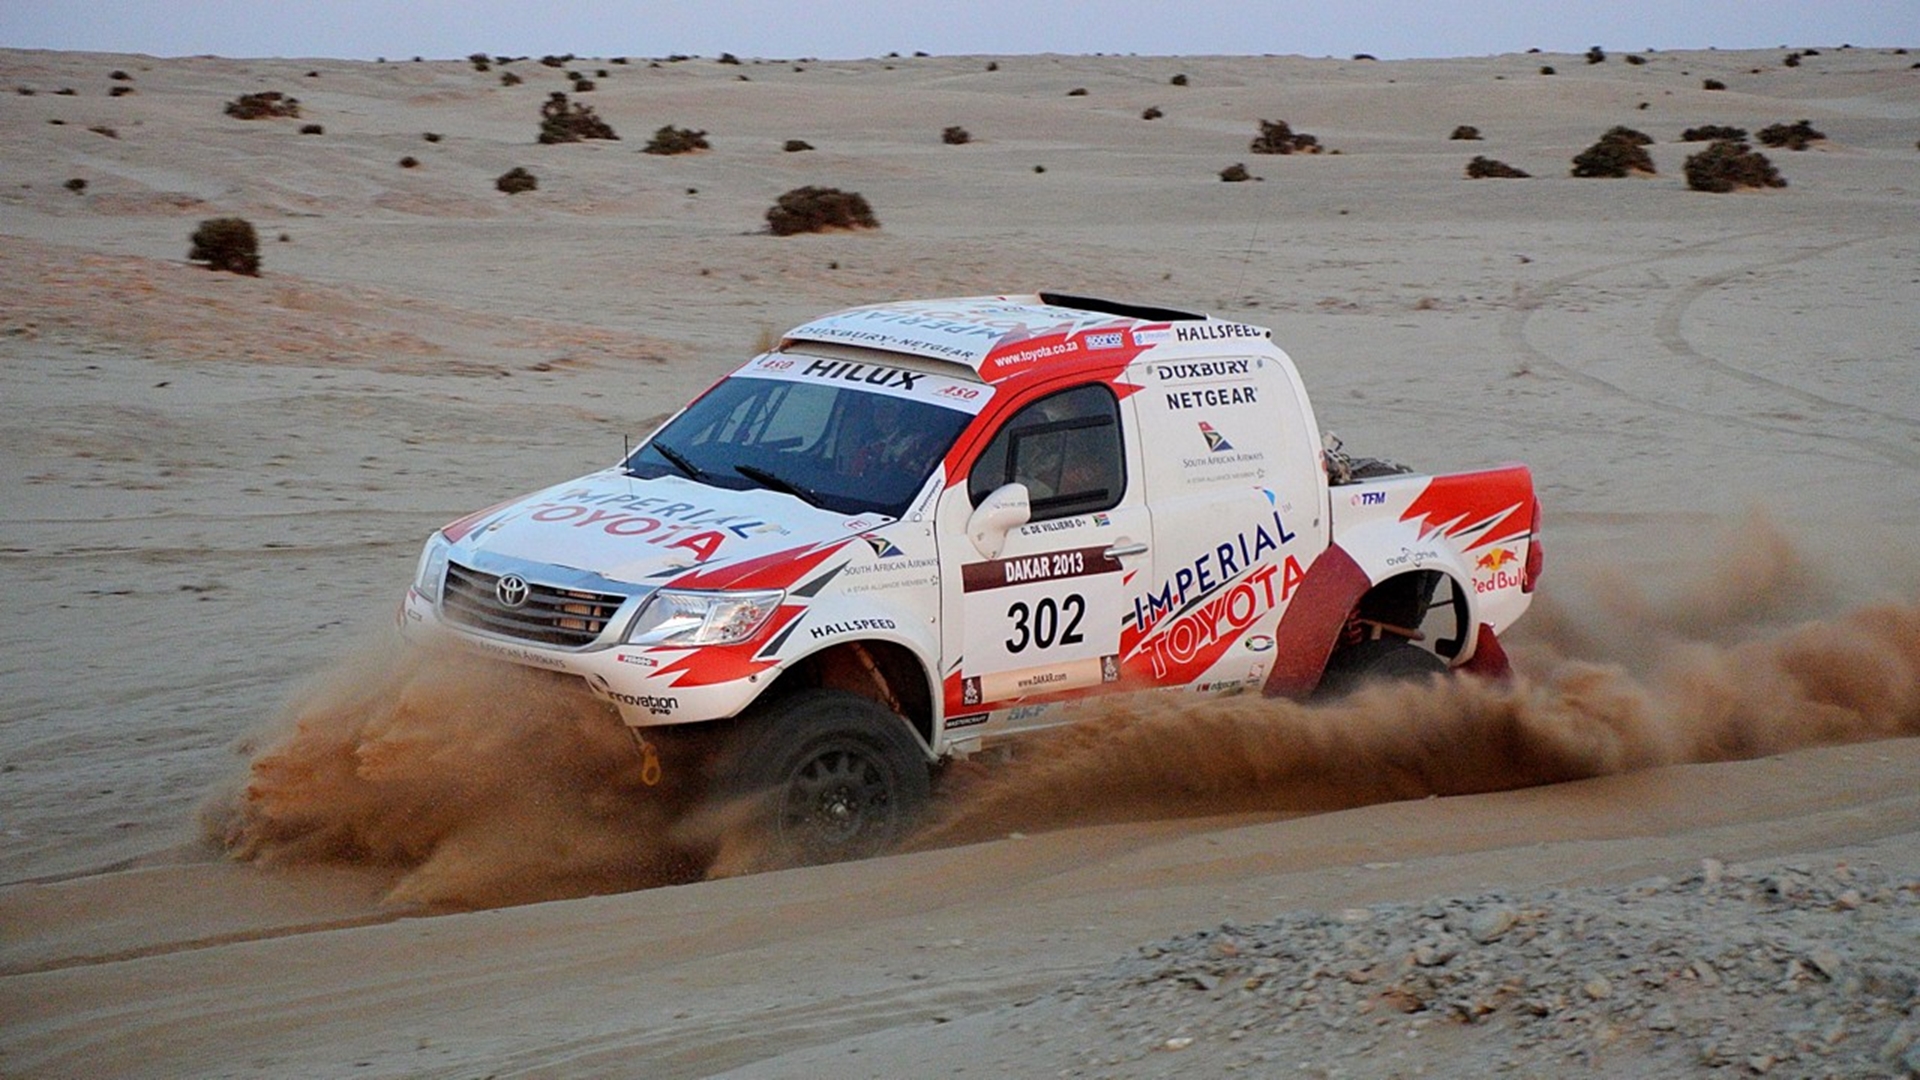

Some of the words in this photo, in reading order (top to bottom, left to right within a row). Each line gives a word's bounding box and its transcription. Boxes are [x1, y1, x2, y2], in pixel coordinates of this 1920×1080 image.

[797, 327, 893, 343] DUXBURY
[899, 338, 974, 360] NETGEAR
[995, 341, 1078, 367] www.toyota.co.za
[802, 359, 927, 390] HILUX
[1157, 359, 1249, 380] DUXBURY
[1166, 387, 1256, 410] NETGEAR
[1361, 492, 1385, 505] TFM
[527, 503, 726, 563] TOYOTA
[1031, 525, 1040, 534] DE
[1043, 520, 1075, 532] VILLIERS
[844, 566, 871, 576] SOUTH
[873, 561, 906, 572] AFRICAN
[907, 558, 938, 568] AIRWAY
[1004, 556, 1050, 582] DAKAR
[1053, 552, 1083, 576] 2013
[1134, 510, 1296, 631] IMPERIAL
[810, 619, 896, 638] HALLSPEED
[1005, 593, 1086, 653] 302
[1140, 554, 1307, 679] TOYOTA
[1018, 672, 1068, 688] www.DAKAR.com
